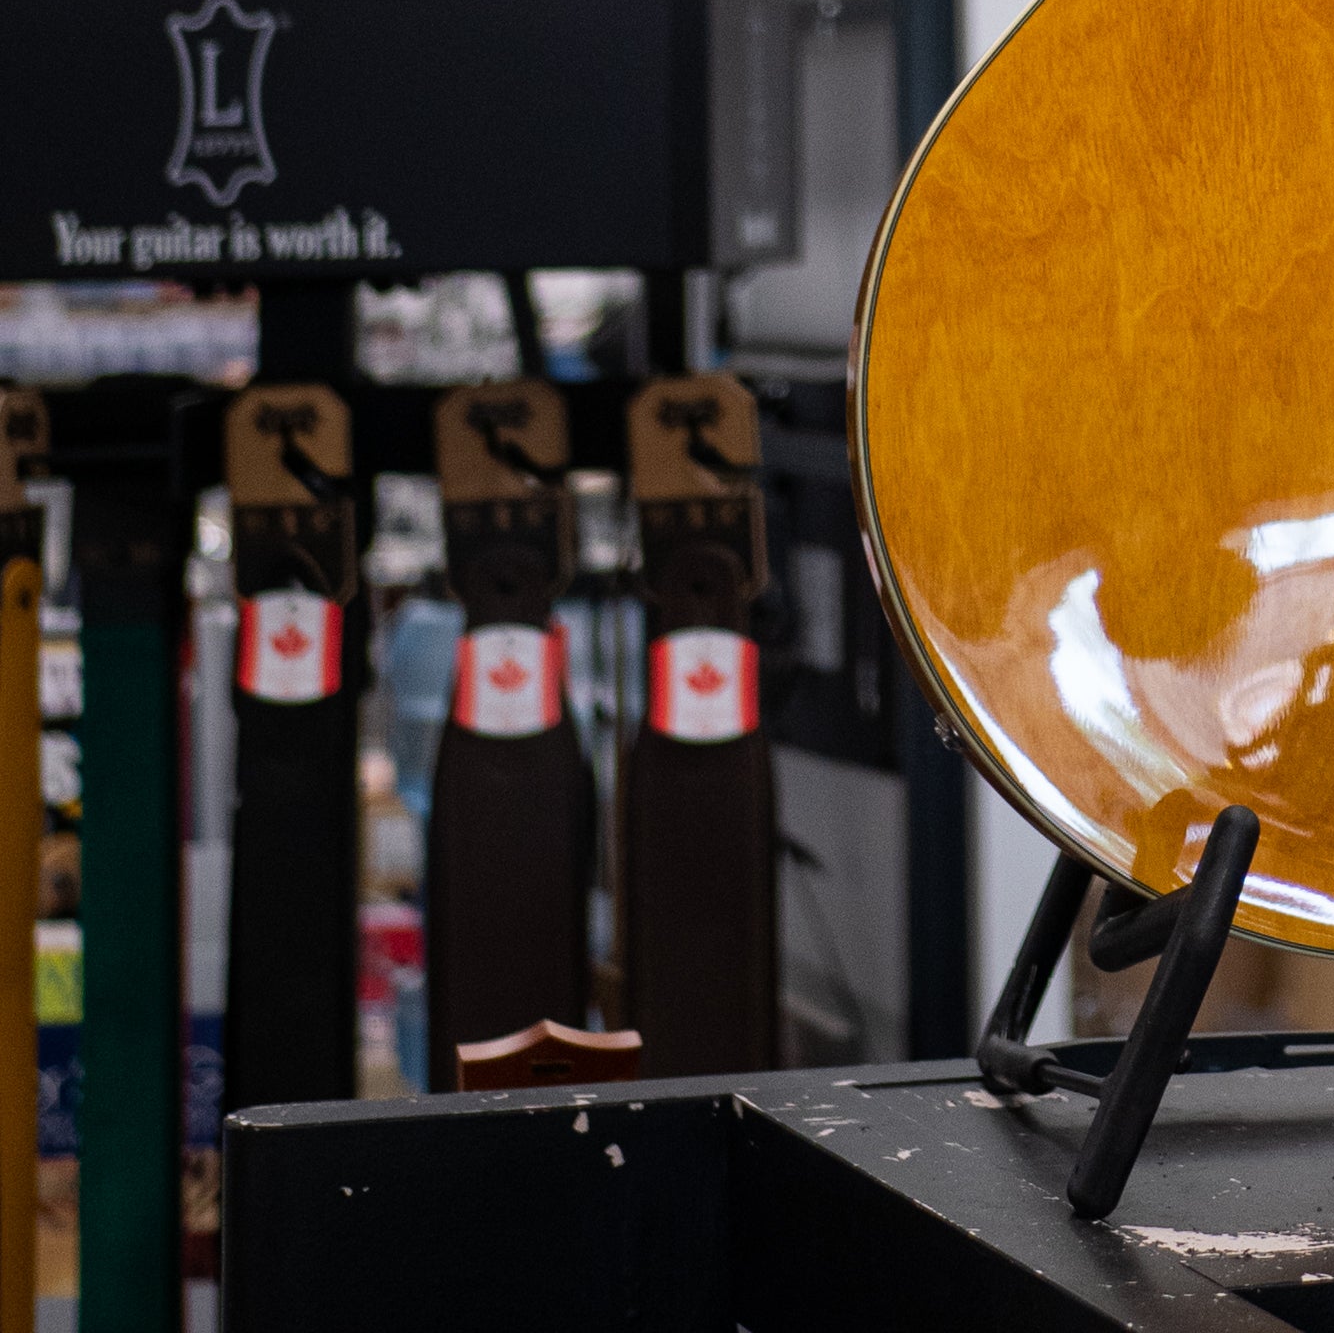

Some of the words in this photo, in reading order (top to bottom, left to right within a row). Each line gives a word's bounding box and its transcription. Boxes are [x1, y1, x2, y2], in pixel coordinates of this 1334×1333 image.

[199, 39, 244, 127] L
[53, 211, 124, 265] Your
[130, 210, 219, 271] guitar
[229, 209, 261, 262] is
[265, 205, 358, 261] worth
[361, 207, 403, 259] it.
